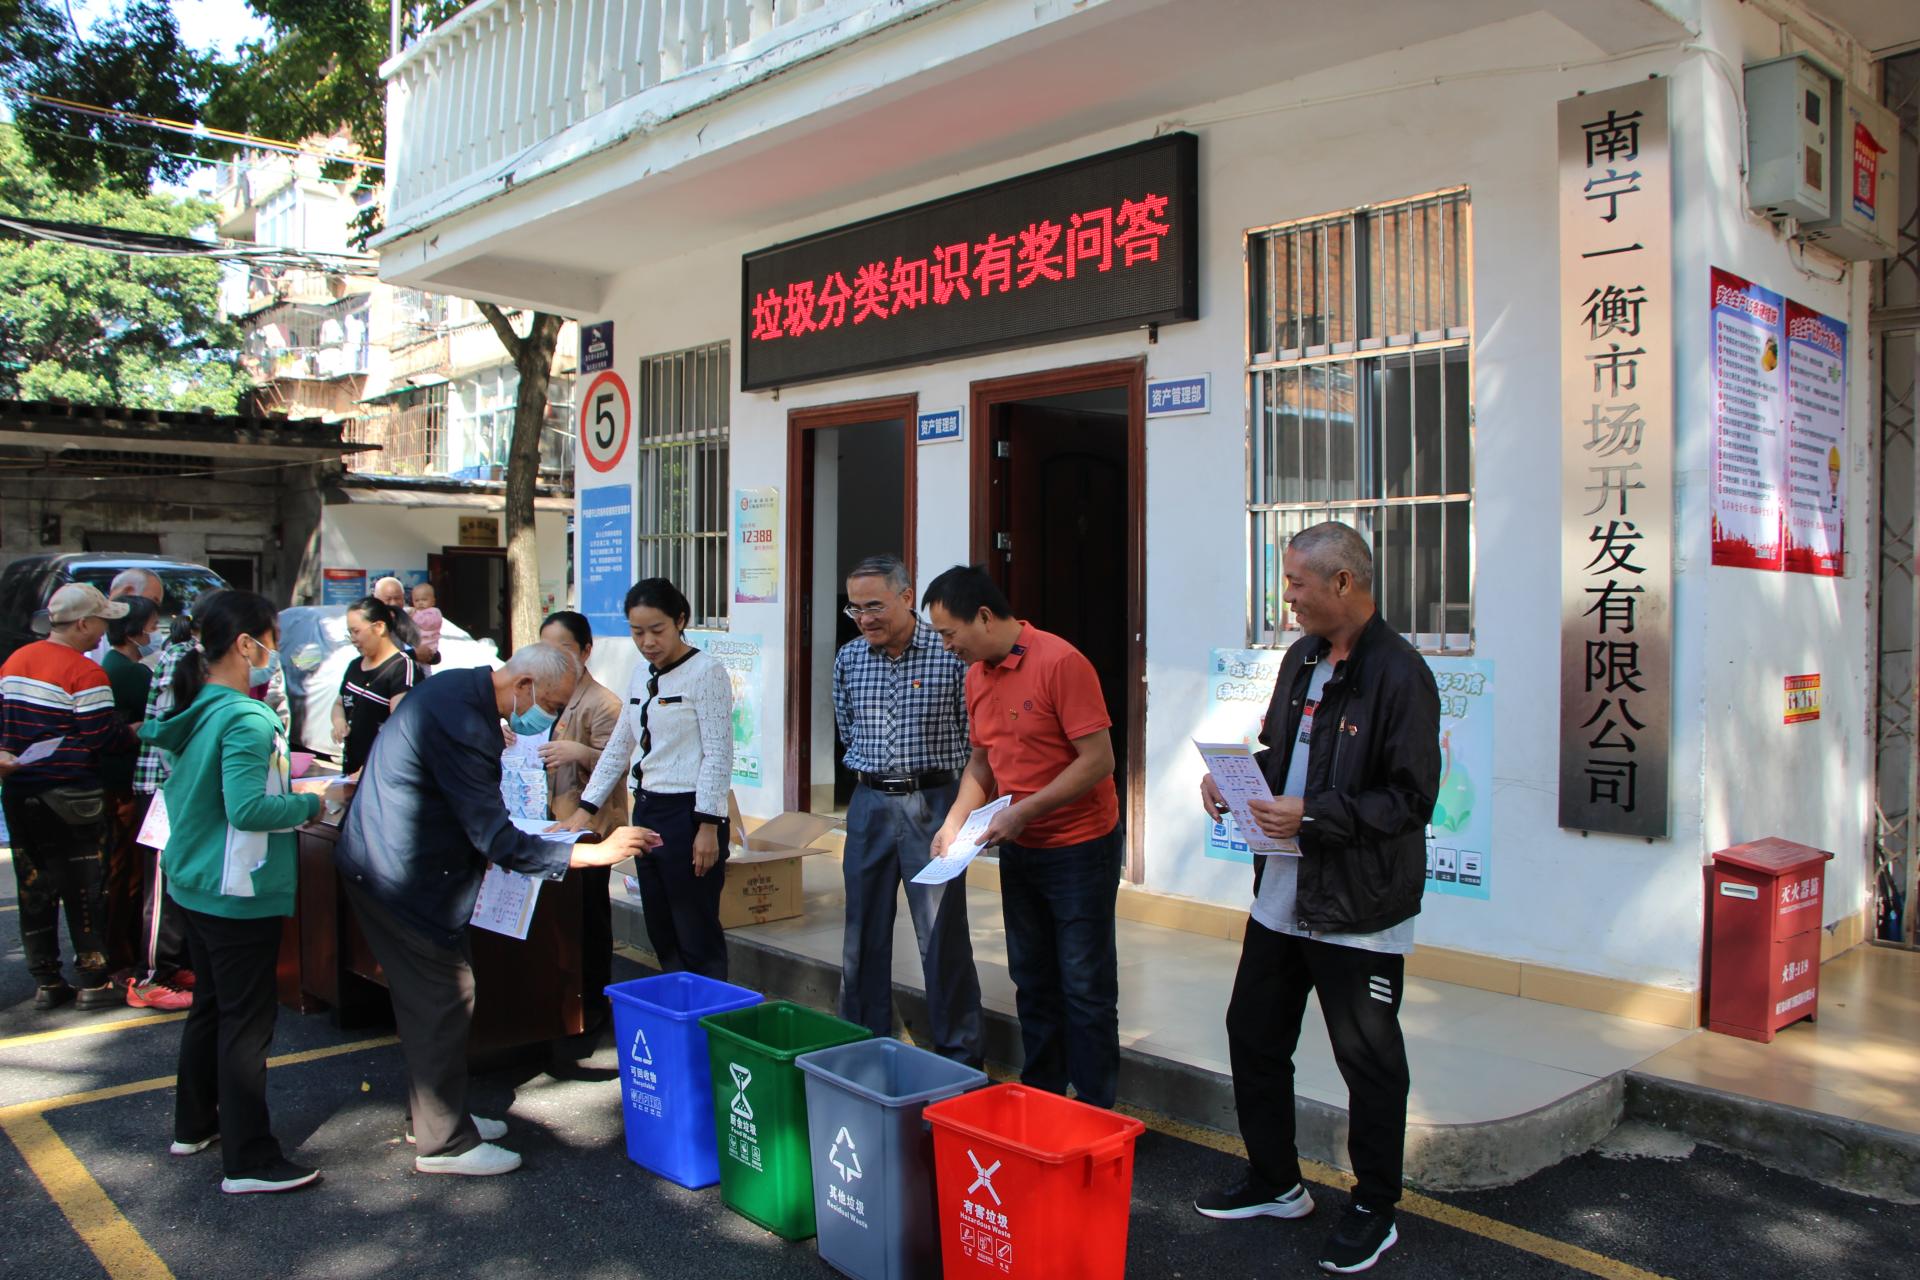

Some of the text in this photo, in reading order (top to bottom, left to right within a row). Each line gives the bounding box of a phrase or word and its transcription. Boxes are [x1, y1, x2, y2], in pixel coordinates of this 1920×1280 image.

[751, 193, 1171, 341] 垃圾分类知识有奖问答
[1152, 385, 1202, 408] 资产管理部
[595, 392, 615, 450] 5
[920, 413, 957, 436] 资产管理部
[1580, 109, 1648, 813] 南宁一衡市场开发有限公司
[742, 529, 773, 543] 12388
[1436, 672, 1486, 696] 好习惯
[1781, 877, 1820, 904] 灭火器箱
[630, 1066, 657, 1084] 可回收物
[729, 1113, 757, 1136] 厨余垃圾
[829, 1184, 865, 1216] 其他垃圾
[850, 1213, 868, 1229] Waste
[959, 1211, 1011, 1239] Hazardous Waste
[963, 1199, 1008, 1229] 有害垃圾
